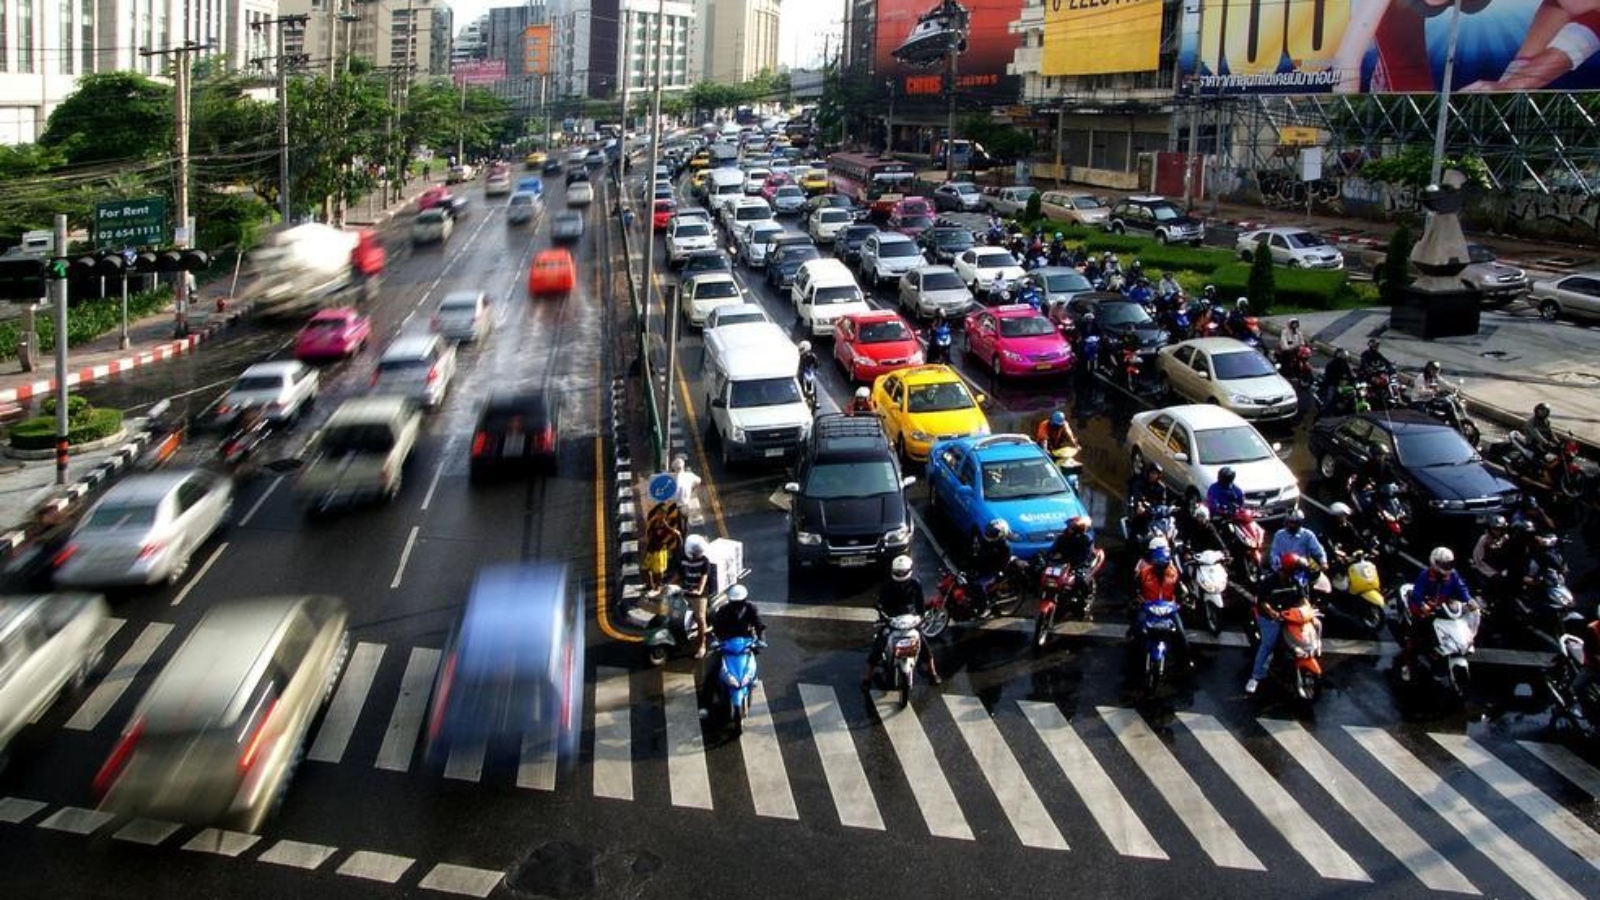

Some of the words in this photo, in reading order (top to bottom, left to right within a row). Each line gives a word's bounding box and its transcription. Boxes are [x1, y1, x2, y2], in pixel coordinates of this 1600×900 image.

[100, 209, 120, 218] For
[123, 206, 149, 217] Rent
[99, 230, 113, 240] 02
